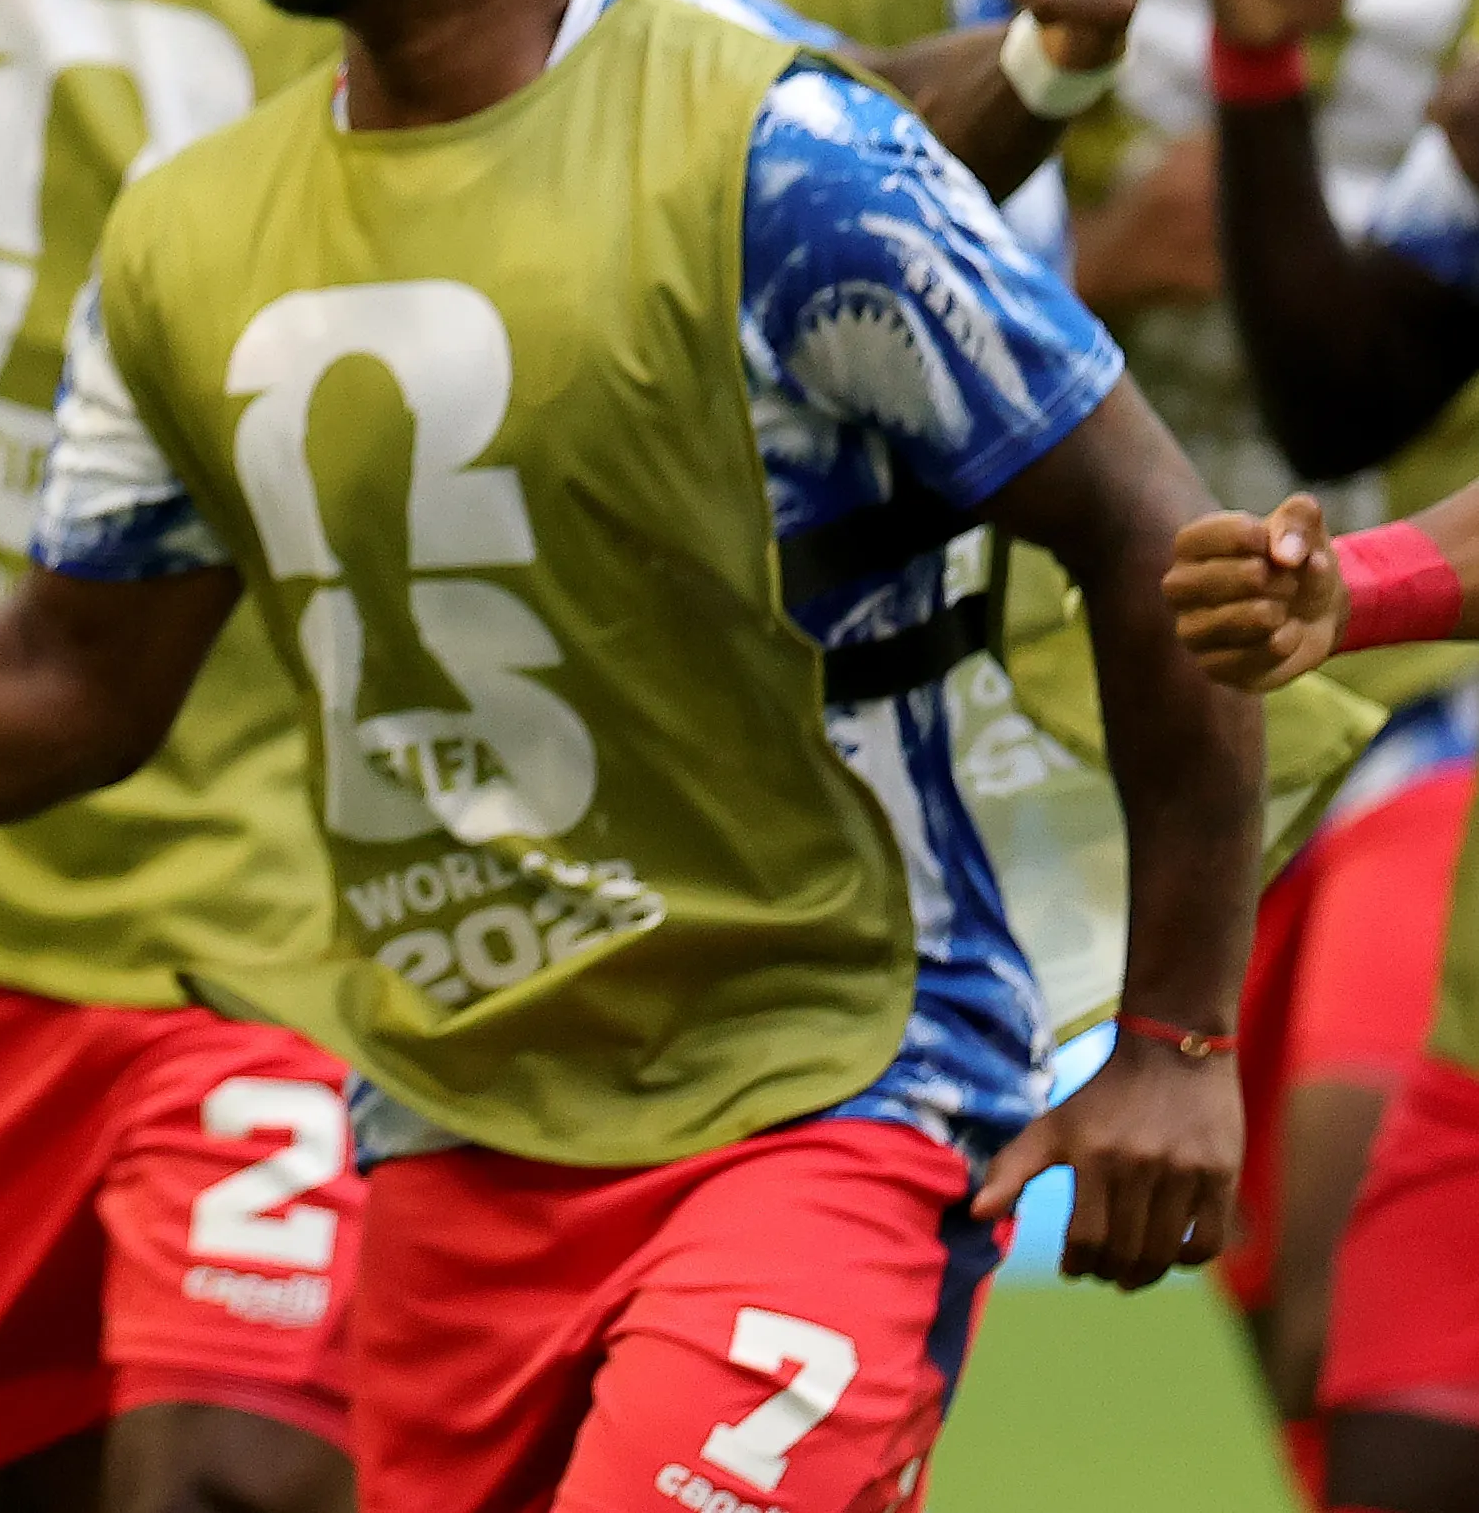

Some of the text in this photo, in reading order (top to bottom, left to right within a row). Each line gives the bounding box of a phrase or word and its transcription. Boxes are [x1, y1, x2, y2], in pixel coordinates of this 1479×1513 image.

[344, 850, 548, 931] WORL
[187, 1075, 347, 1271] 2
[700, 1305, 861, 1493] 7
